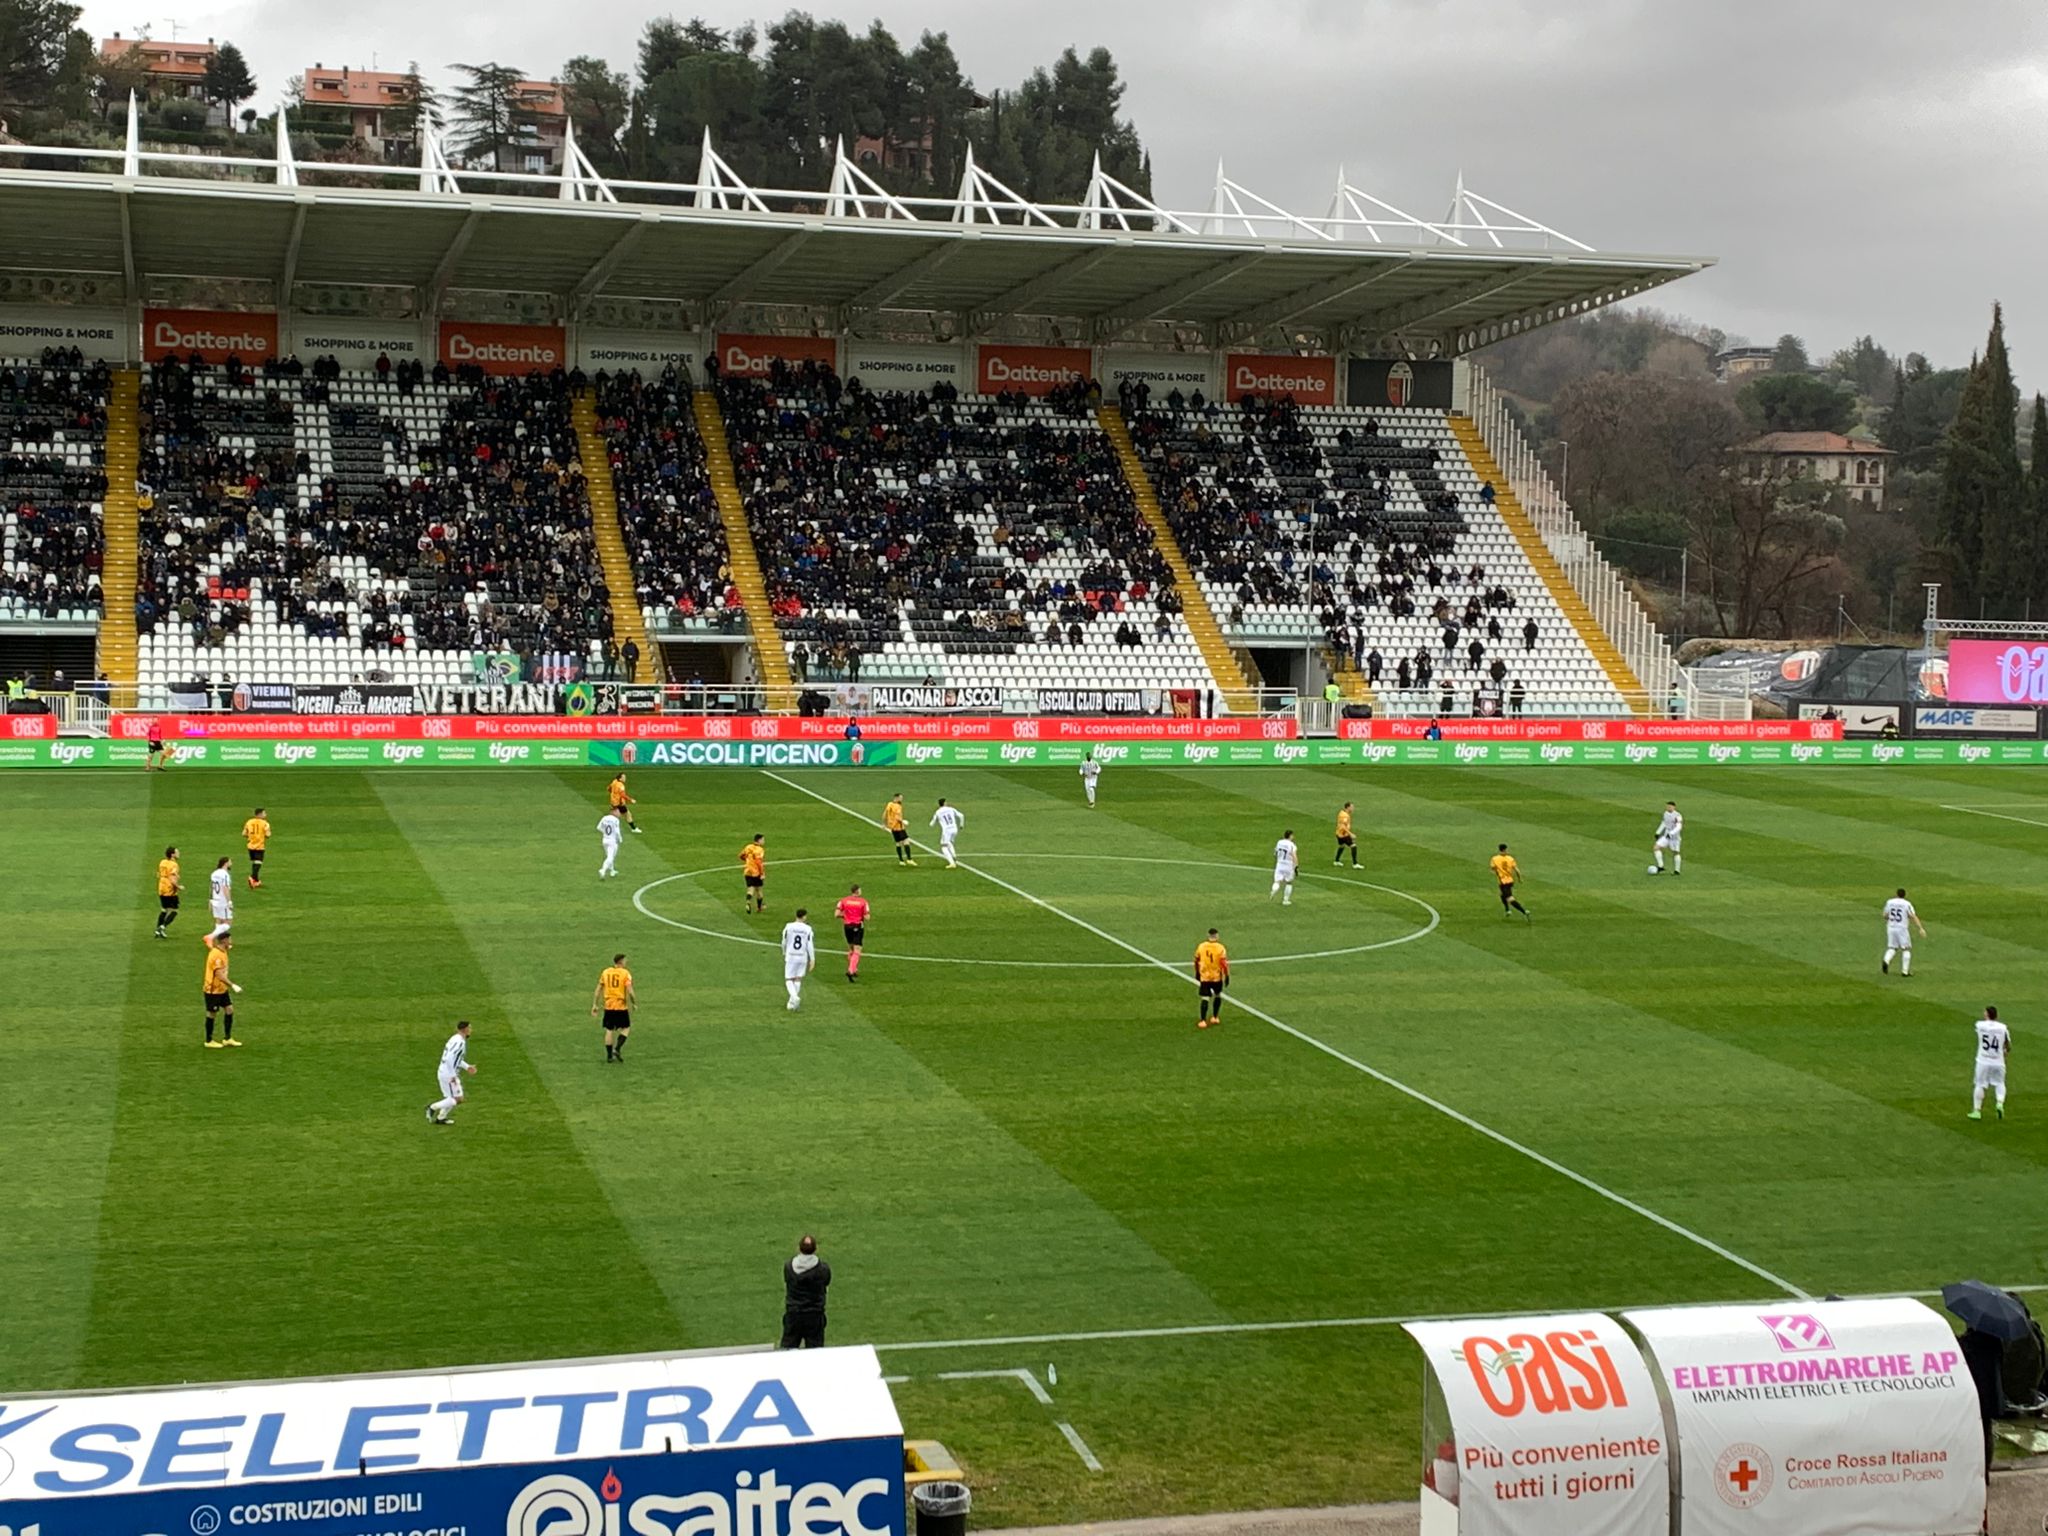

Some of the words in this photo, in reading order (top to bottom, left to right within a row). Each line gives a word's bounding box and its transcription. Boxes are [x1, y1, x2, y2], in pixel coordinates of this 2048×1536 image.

[0, 326, 63, 338] SHOPPING
[66, 329, 74, 338] &
[77, 329, 114, 340] MORE
[155, 322, 267, 352] Battente
[304, 338, 367, 350] SHOPPING
[368, 340, 377, 351] &
[378, 340, 414, 352] MORE
[450, 335, 555, 363] Battente
[590, 350, 648, 361] SHOPPING
[650, 352, 658, 361] &
[660, 352, 693, 363] MORE
[859, 361, 913, 373] SHOPPING
[916, 364, 923, 373] &
[925, 363, 956, 374] MORE
[1113, 370, 1165, 381] SHOPPING
[1167, 372, 1174, 381] &
[1176, 373, 1206, 383] MORE
[1236, 366, 1326, 392] Battente
[252, 686, 290, 697] VIENNA
[421, 684, 556, 713] VETERANI
[873, 688, 945, 707] PALLONARI
[956, 687, 1002, 707] ASCOLI
[297, 696, 334, 714] PICENI
[335, 704, 366, 715] DELLE
[367, 696, 412, 715] MARCHE
[1038, 692, 1074, 711] ASCOLI
[1076, 692, 1102, 710] CLUB
[1105, 692, 1141, 711] OFFIDA
[1810, 708, 1843, 717] TEM
[208, 721, 304, 733] conveniente
[308, 719, 339, 733] tutti
[352, 719, 396, 737] giorni
[475, 719, 499, 733] Più
[503, 721, 592, 734] conveniente
[596, 720, 626, 734] tutti
[637, 720, 680, 737] giorni
[801, 720, 823, 733] Più
[913, 720, 941, 734] tutti
[951, 720, 990, 737] giorni
[1060, 721, 1081, 734] Più
[1084, 722, 1164, 735] conveniente
[1168, 721, 1194, 735] tutti
[1204, 721, 1241, 738] giorni
[1392, 722, 1412, 734] Più
[1493, 722, 1518, 735] tutti
[1527, 722, 1561, 738] giorni
[1625, 722, 1644, 735] Più
[1647, 724, 1720, 736] conveniente
[1723, 723, 1748, 736] tutti
[1757, 723, 1791, 738] giorni
[50, 742, 95, 763] tigre
[274, 742, 317, 763] tigre
[382, 742, 425, 763] tigre
[488, 742, 530, 763] tigre
[652, 742, 744, 764] ASCOLI
[751, 742, 838, 764] PICENO
[906, 743, 943, 763] tigre
[1000, 743, 1037, 763] tigre
[1092, 743, 1128, 762] tigre
[1184, 743, 1219, 762] tigre
[1273, 743, 1308, 762] tigre
[1362, 743, 1396, 761] tigre
[1455, 743, 1488, 761] tigre
[1540, 743, 1573, 761] tigre
[1625, 743, 1658, 761] tigre
[1708, 743, 1741, 761] tigre
[1791, 743, 1824, 761] tigre
[1872, 743, 1904, 761] tigre
[1958, 743, 1991, 762] tigre
[1890, 908, 1903, 922] 55
[793, 935, 802, 950] 8
[1206, 950, 1214, 963] 4
[607, 973, 619, 988] 16
[1982, 1034, 1999, 1052] 54
[1673, 1354, 1912, 1389] ELETTROMARCHE
[1922, 1351, 1958, 1376] AP
[1692, 1386, 1761, 1404] IMPIANTI
[1765, 1382, 1837, 1400] ELETTRICI
[1842, 1381, 1850, 1395] E
[1852, 1375, 1956, 1395] TECNOLOGICI
[34, 1379, 815, 1493] SELETTRA
[1464, 1446, 1504, 1470] Più
[1512, 1436, 1661, 1466] conveniente
[1786, 1457, 1831, 1473] Croce
[1837, 1453, 1887, 1468] Rossa
[1892, 1449, 1948, 1465] Italiana
[1495, 1476, 1544, 1500] tutti
[1552, 1474, 1558, 1495] i
[1566, 1468, 1635, 1499] giorni
[229, 1496, 367, 1525] COSTRUZIONI
[374, 1493, 422, 1515] EDILI
